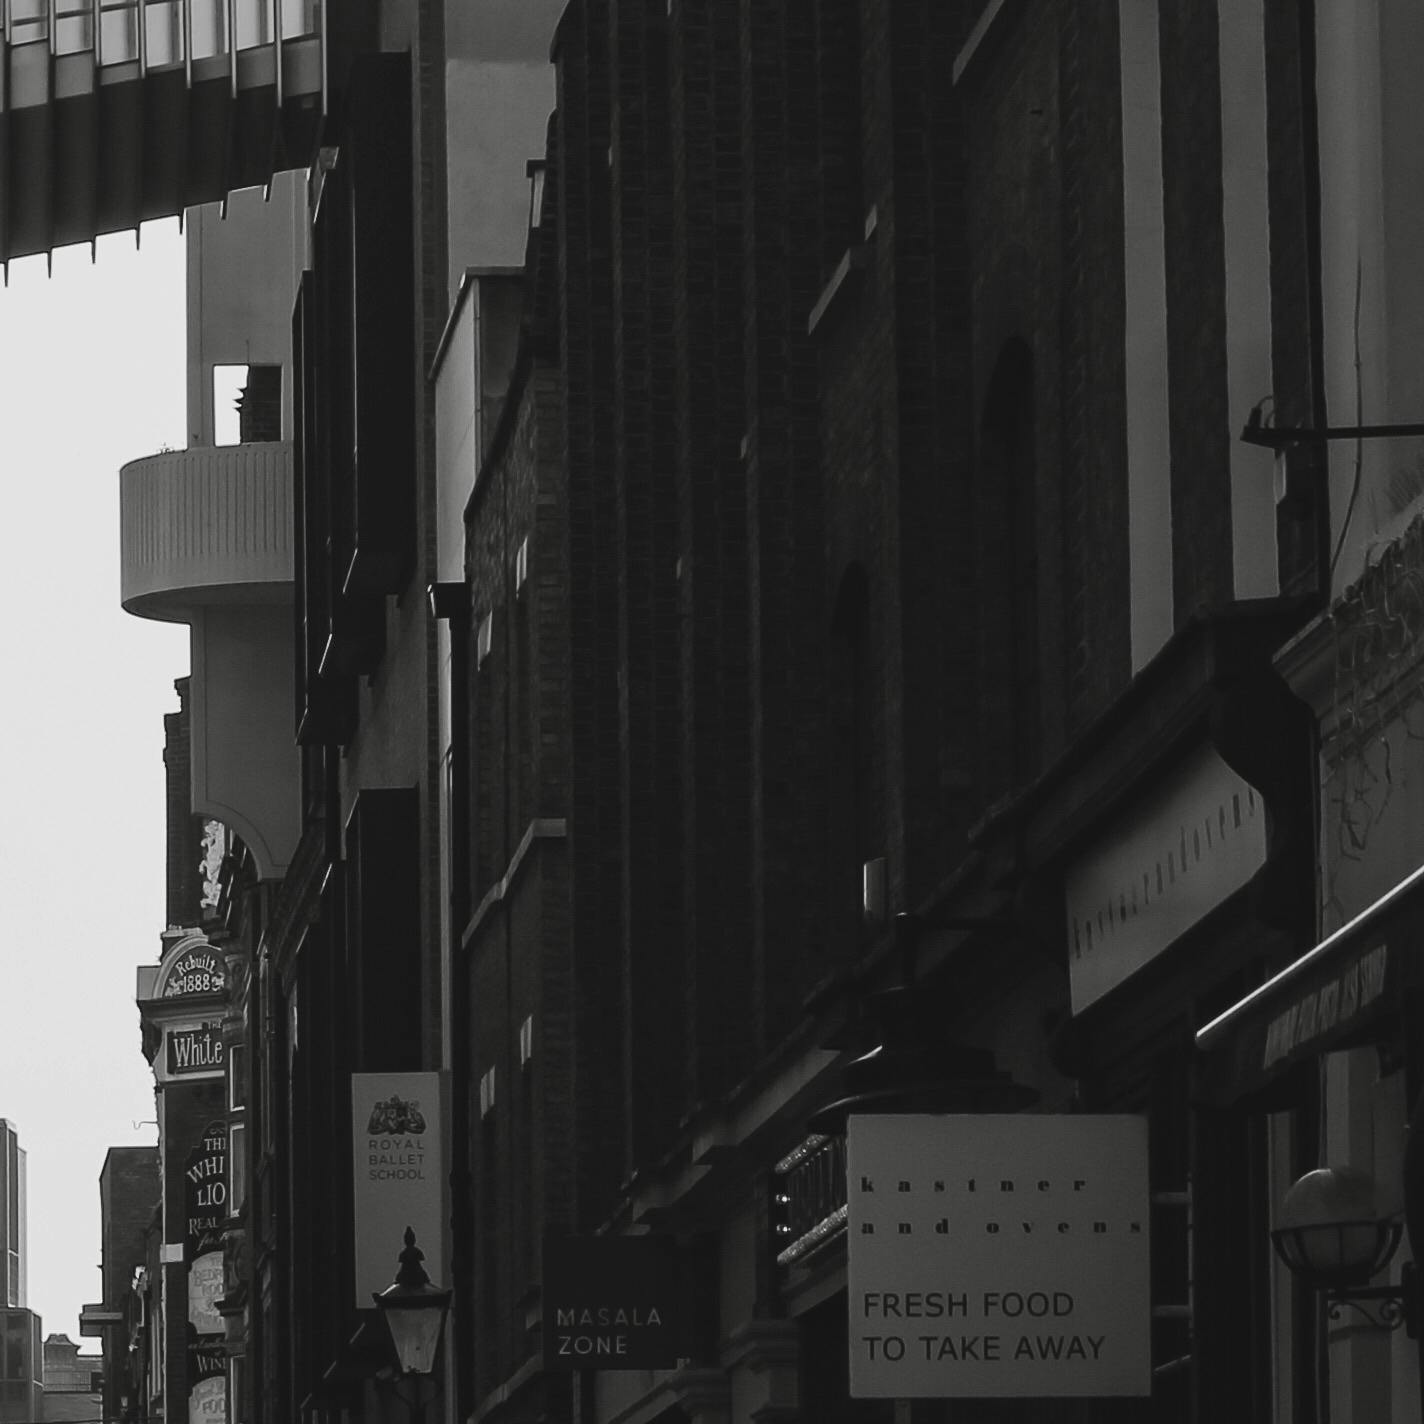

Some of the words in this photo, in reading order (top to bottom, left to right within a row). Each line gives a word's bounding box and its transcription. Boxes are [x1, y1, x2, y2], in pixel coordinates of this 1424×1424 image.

[175, 954, 218, 976] Rebuilt
[183, 973, 211, 993] 1888
[173, 1033, 223, 1067] White
[369, 1139, 424, 1150] ROYAL
[369, 1154, 424, 1165] BALLET
[369, 1169, 425, 1180] SCHOOL
[861, 1176, 1087, 1193] kastner
[861, 1217, 949, 1234] and
[985, 1220, 1141, 1234] ovens
[863, 1292, 969, 1318] FRESH
[983, 1292, 1075, 1318] FOOD
[557, 1306, 663, 1327] MASALA
[558, 1335, 628, 1355] ZONE
[862, 1336, 907, 1361] TO
[918, 1336, 1001, 1361] TAKE
[1014, 1336, 1106, 1361] AWAY
